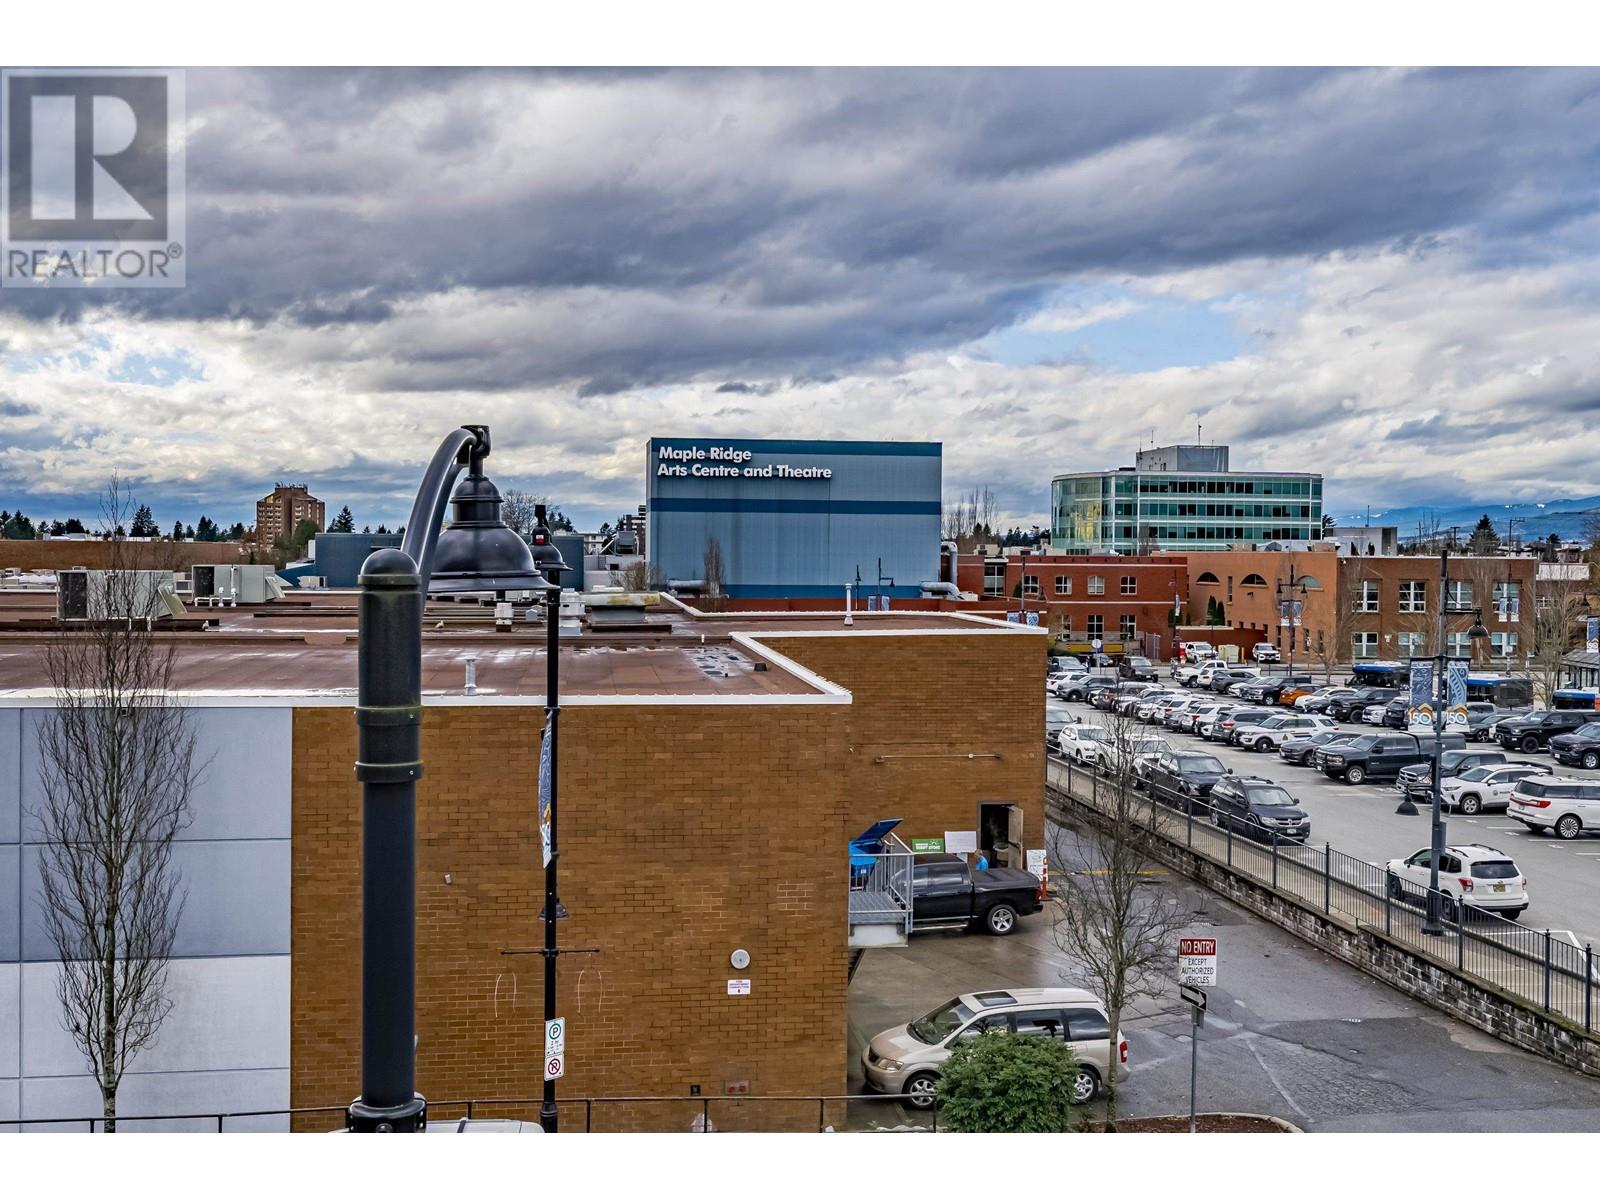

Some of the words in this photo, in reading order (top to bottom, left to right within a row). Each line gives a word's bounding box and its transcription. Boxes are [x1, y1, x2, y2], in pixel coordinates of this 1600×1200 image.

[659, 446, 706, 462] Maple
[710, 447, 752, 464] Ridge
[657, 463, 688, 477] Arts
[691, 463, 740, 478] Centre
[743, 464, 773, 478] and
[776, 464, 833, 479] Theatre
[1409, 712, 1432, 725] 150
[1446, 711, 1467, 724] 150
[1182, 941, 1192, 953] NO
[1194, 941, 1214, 953] ENTRY
